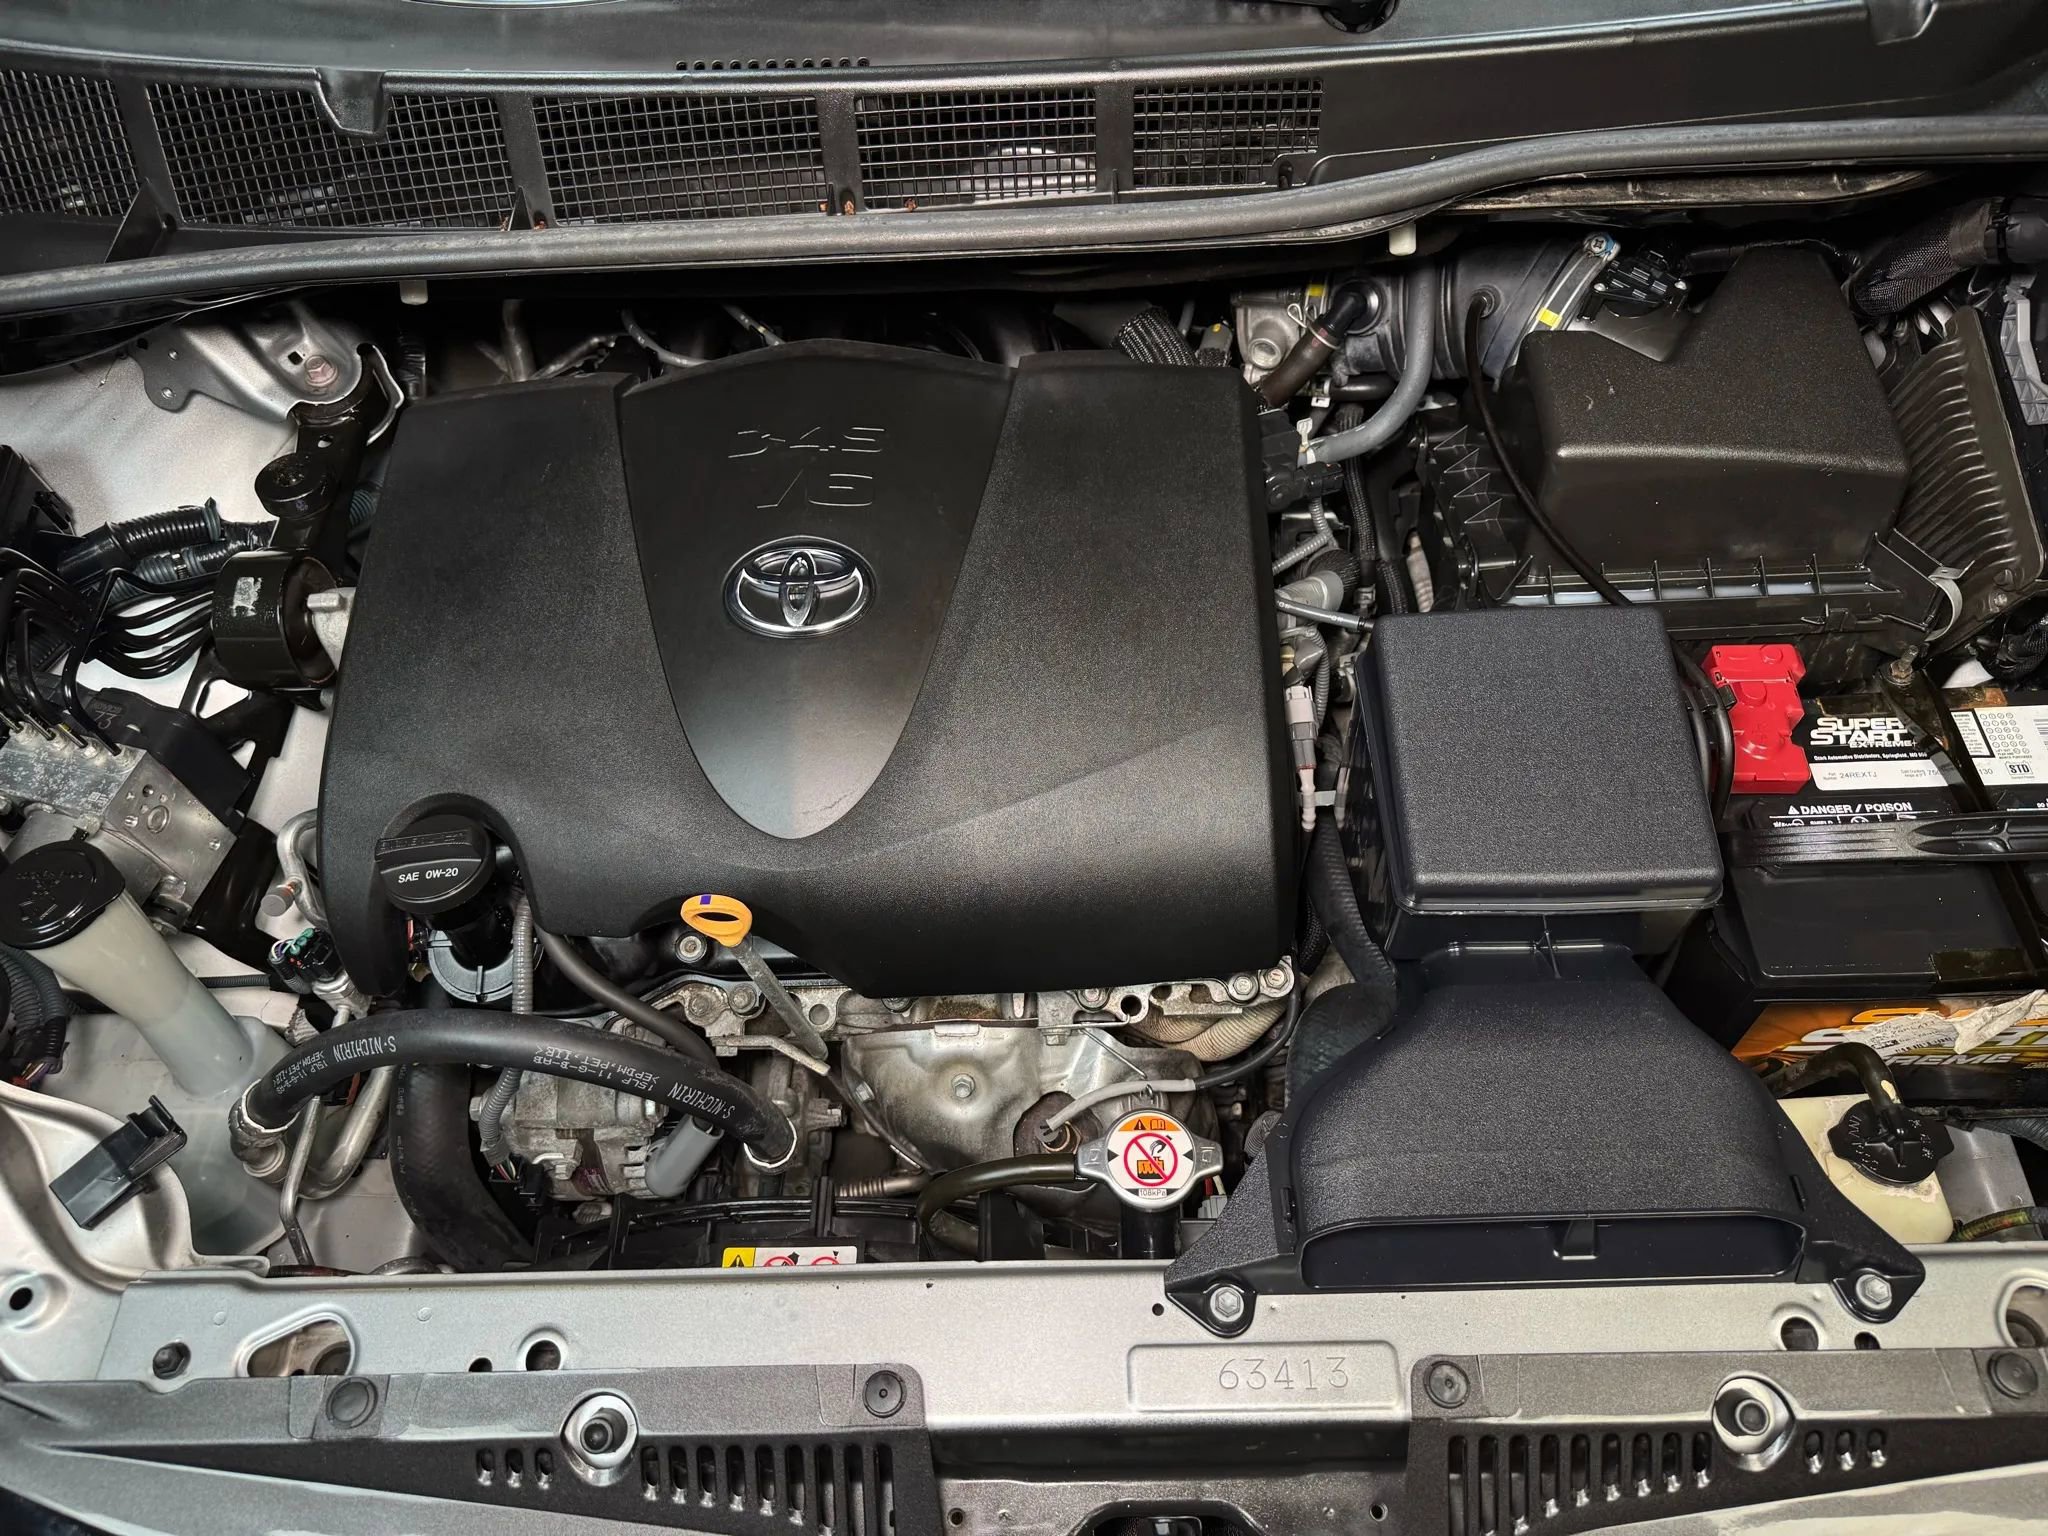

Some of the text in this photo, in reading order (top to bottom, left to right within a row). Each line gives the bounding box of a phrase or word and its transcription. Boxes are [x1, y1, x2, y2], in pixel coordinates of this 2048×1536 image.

[1817, 717, 1905, 732] SUPER
[1810, 729, 1908, 746] START
[2008, 764, 2030, 774] STD
[1800, 804, 1853, 815] DANGER
[1866, 802, 1913, 813] POISON
[397, 866, 460, 884] SAE 0W-20
[1218, 1356, 1350, 1390] 63413
